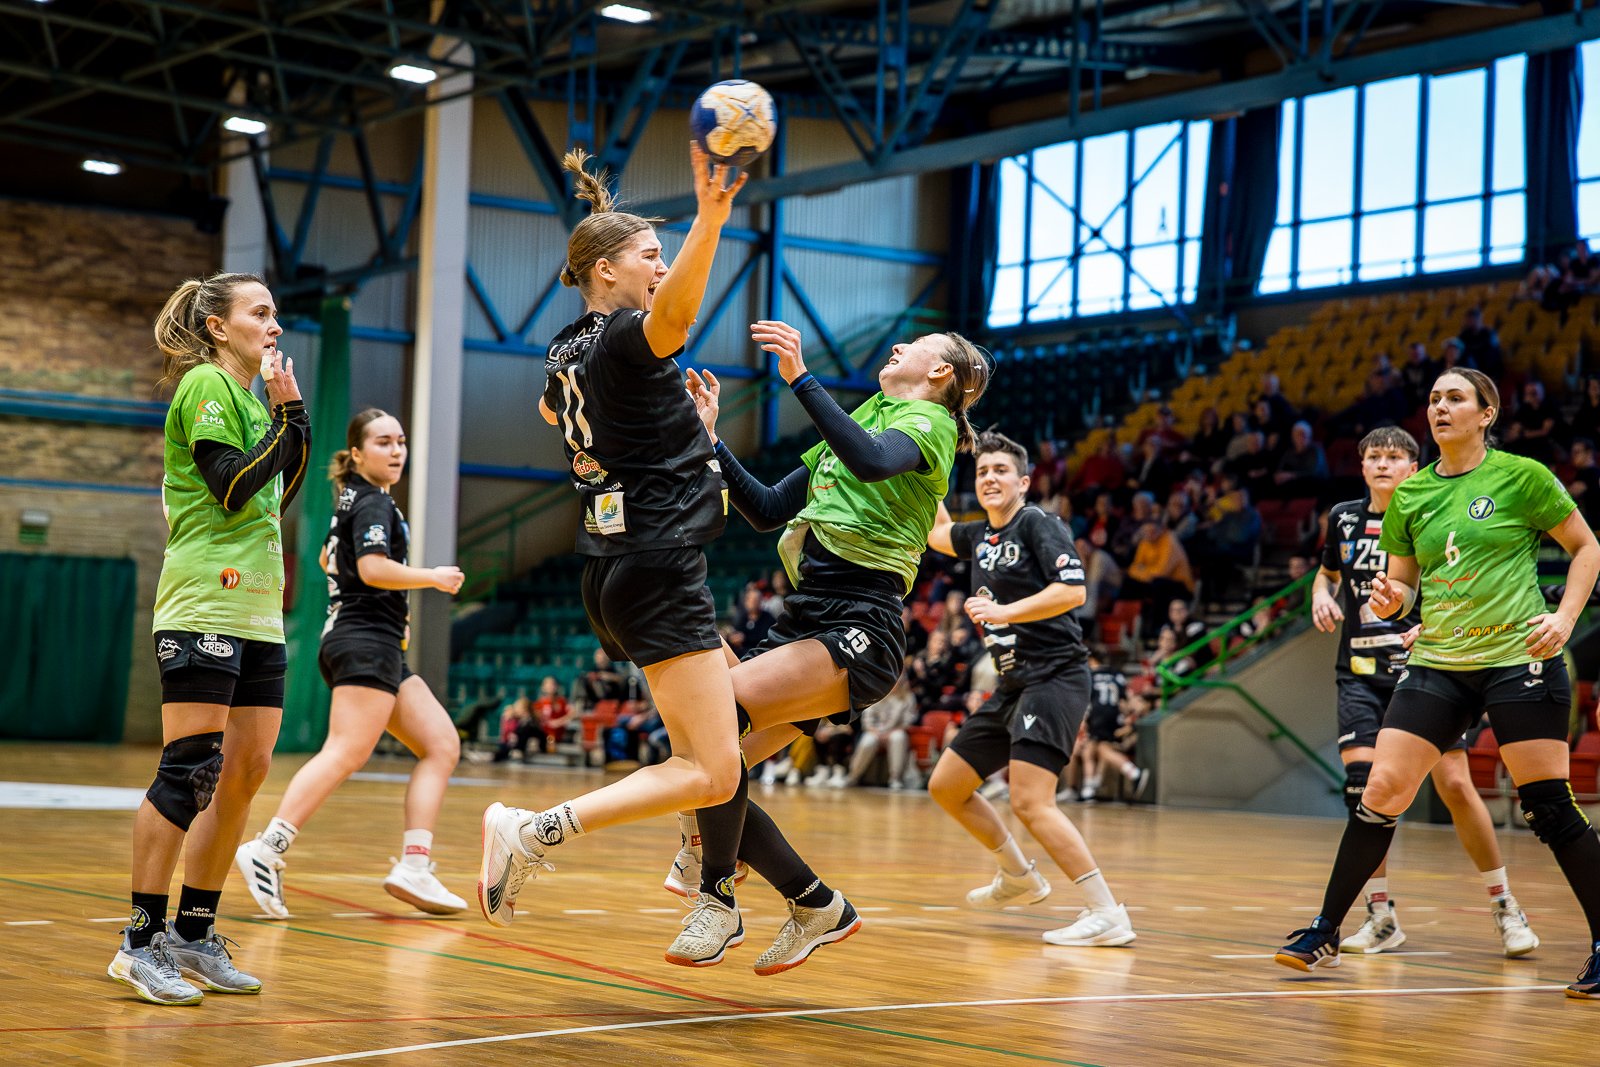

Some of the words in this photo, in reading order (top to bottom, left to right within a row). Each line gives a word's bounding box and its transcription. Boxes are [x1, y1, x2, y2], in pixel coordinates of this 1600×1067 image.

[555, 365, 593, 452] 11
[1353, 538, 1387, 571] 25
[1444, 531, 1460, 567] 6
[241, 570, 273, 589] eco
[202, 642, 232, 654] ZREMB
[204, 633, 218, 642] BGI
[844, 626, 872, 655] 15
